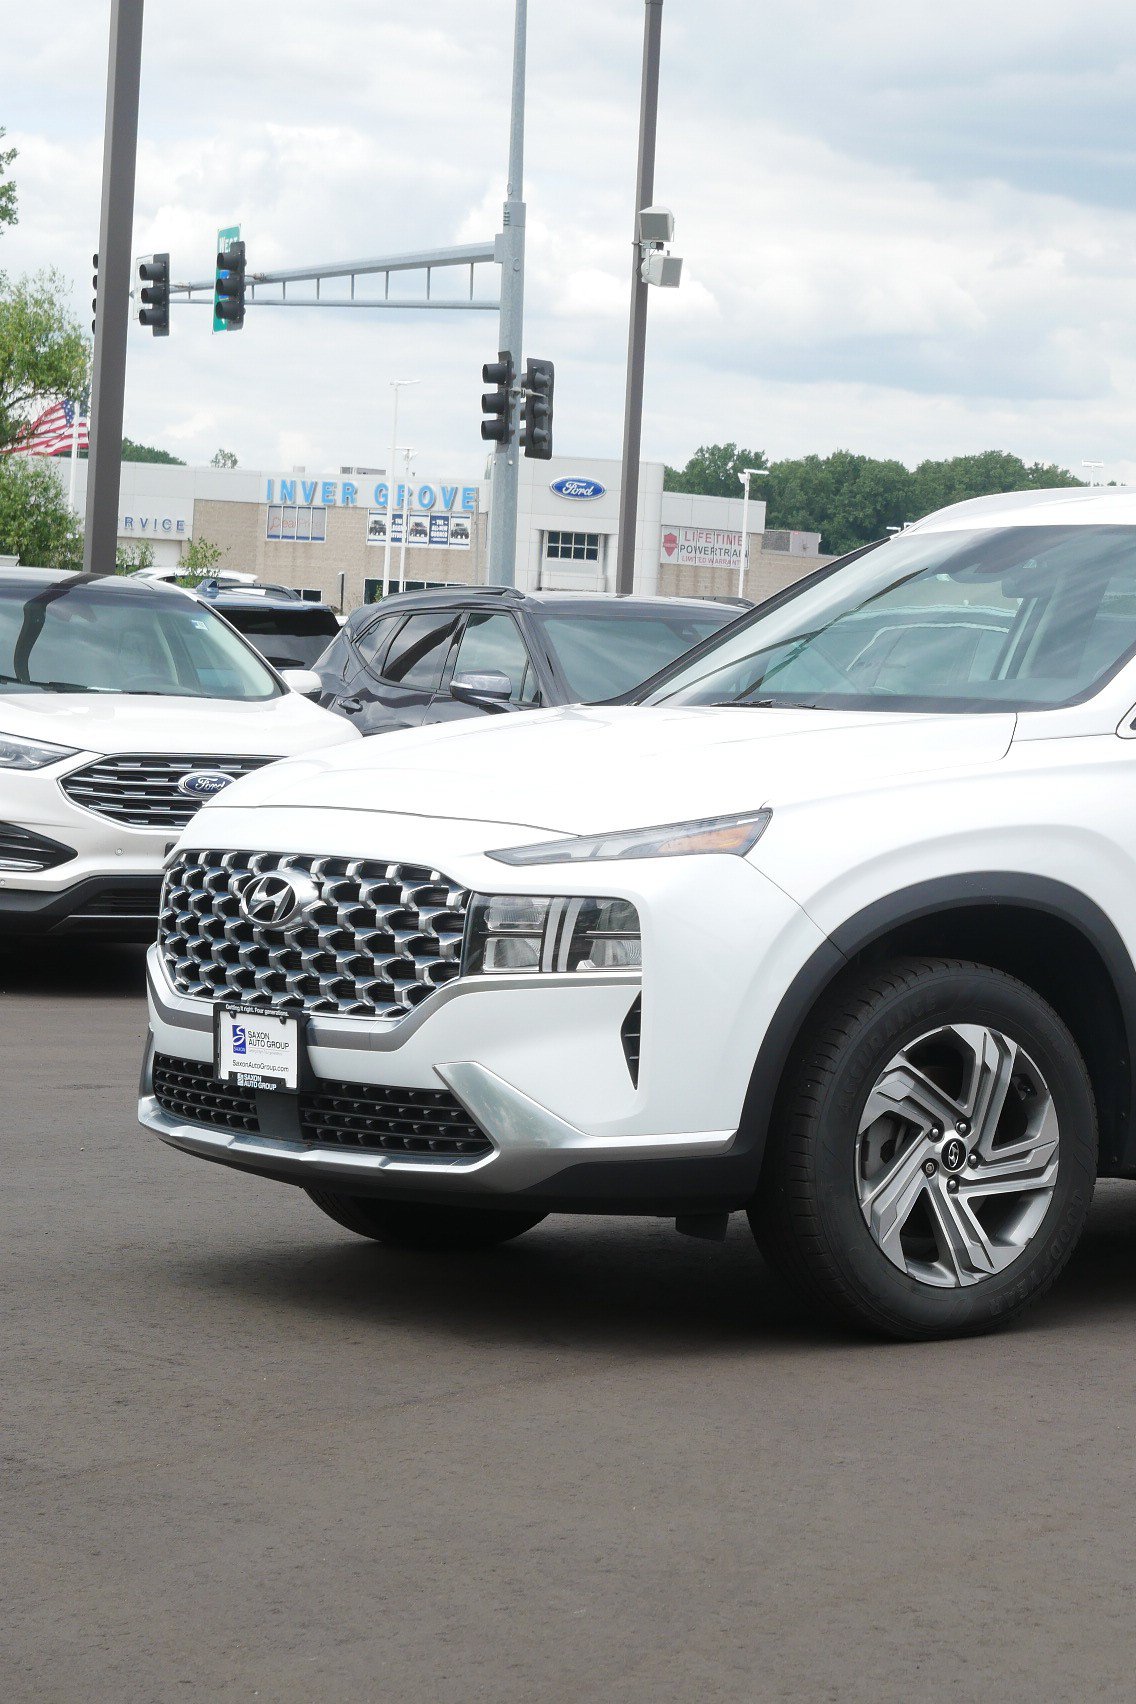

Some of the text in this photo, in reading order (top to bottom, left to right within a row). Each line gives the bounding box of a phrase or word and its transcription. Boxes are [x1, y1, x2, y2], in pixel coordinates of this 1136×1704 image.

[266, 479, 477, 511] INVER GROVE
[562, 481, 595, 496] Ford
[124, 516, 185, 531] RVICE
[685, 531, 743, 546] LIFETIME
[709, 558, 743, 566] WARRANT
[195, 777, 226, 791] Ford
[248, 1031, 270, 1040] SAXON
[248, 1039, 290, 1050] AUTO GROUP
[232, 1060, 289, 1072] SaxonAutoGroup.com
[244, 1073, 262, 1082] SAXON
